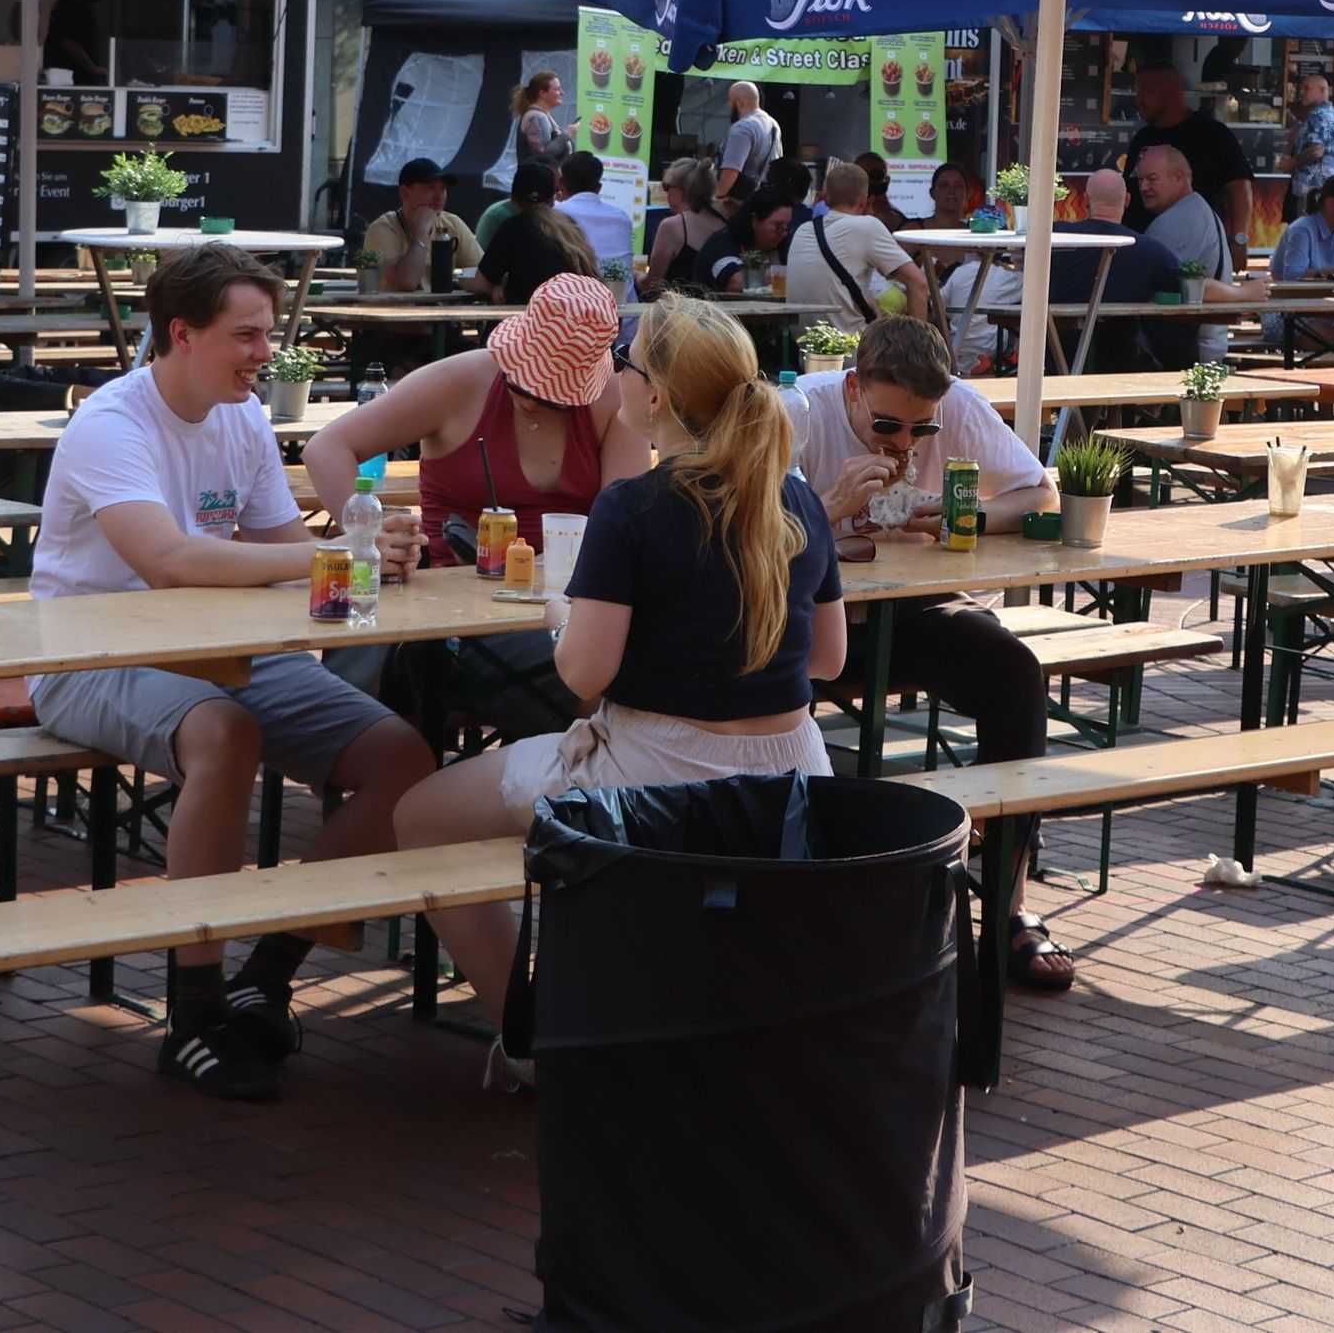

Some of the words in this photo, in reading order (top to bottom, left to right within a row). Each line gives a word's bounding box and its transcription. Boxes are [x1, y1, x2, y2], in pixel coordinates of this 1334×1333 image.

[750, 45, 762, 66] &
[767, 49, 822, 69] Street
[40, 186, 71, 198] Event
